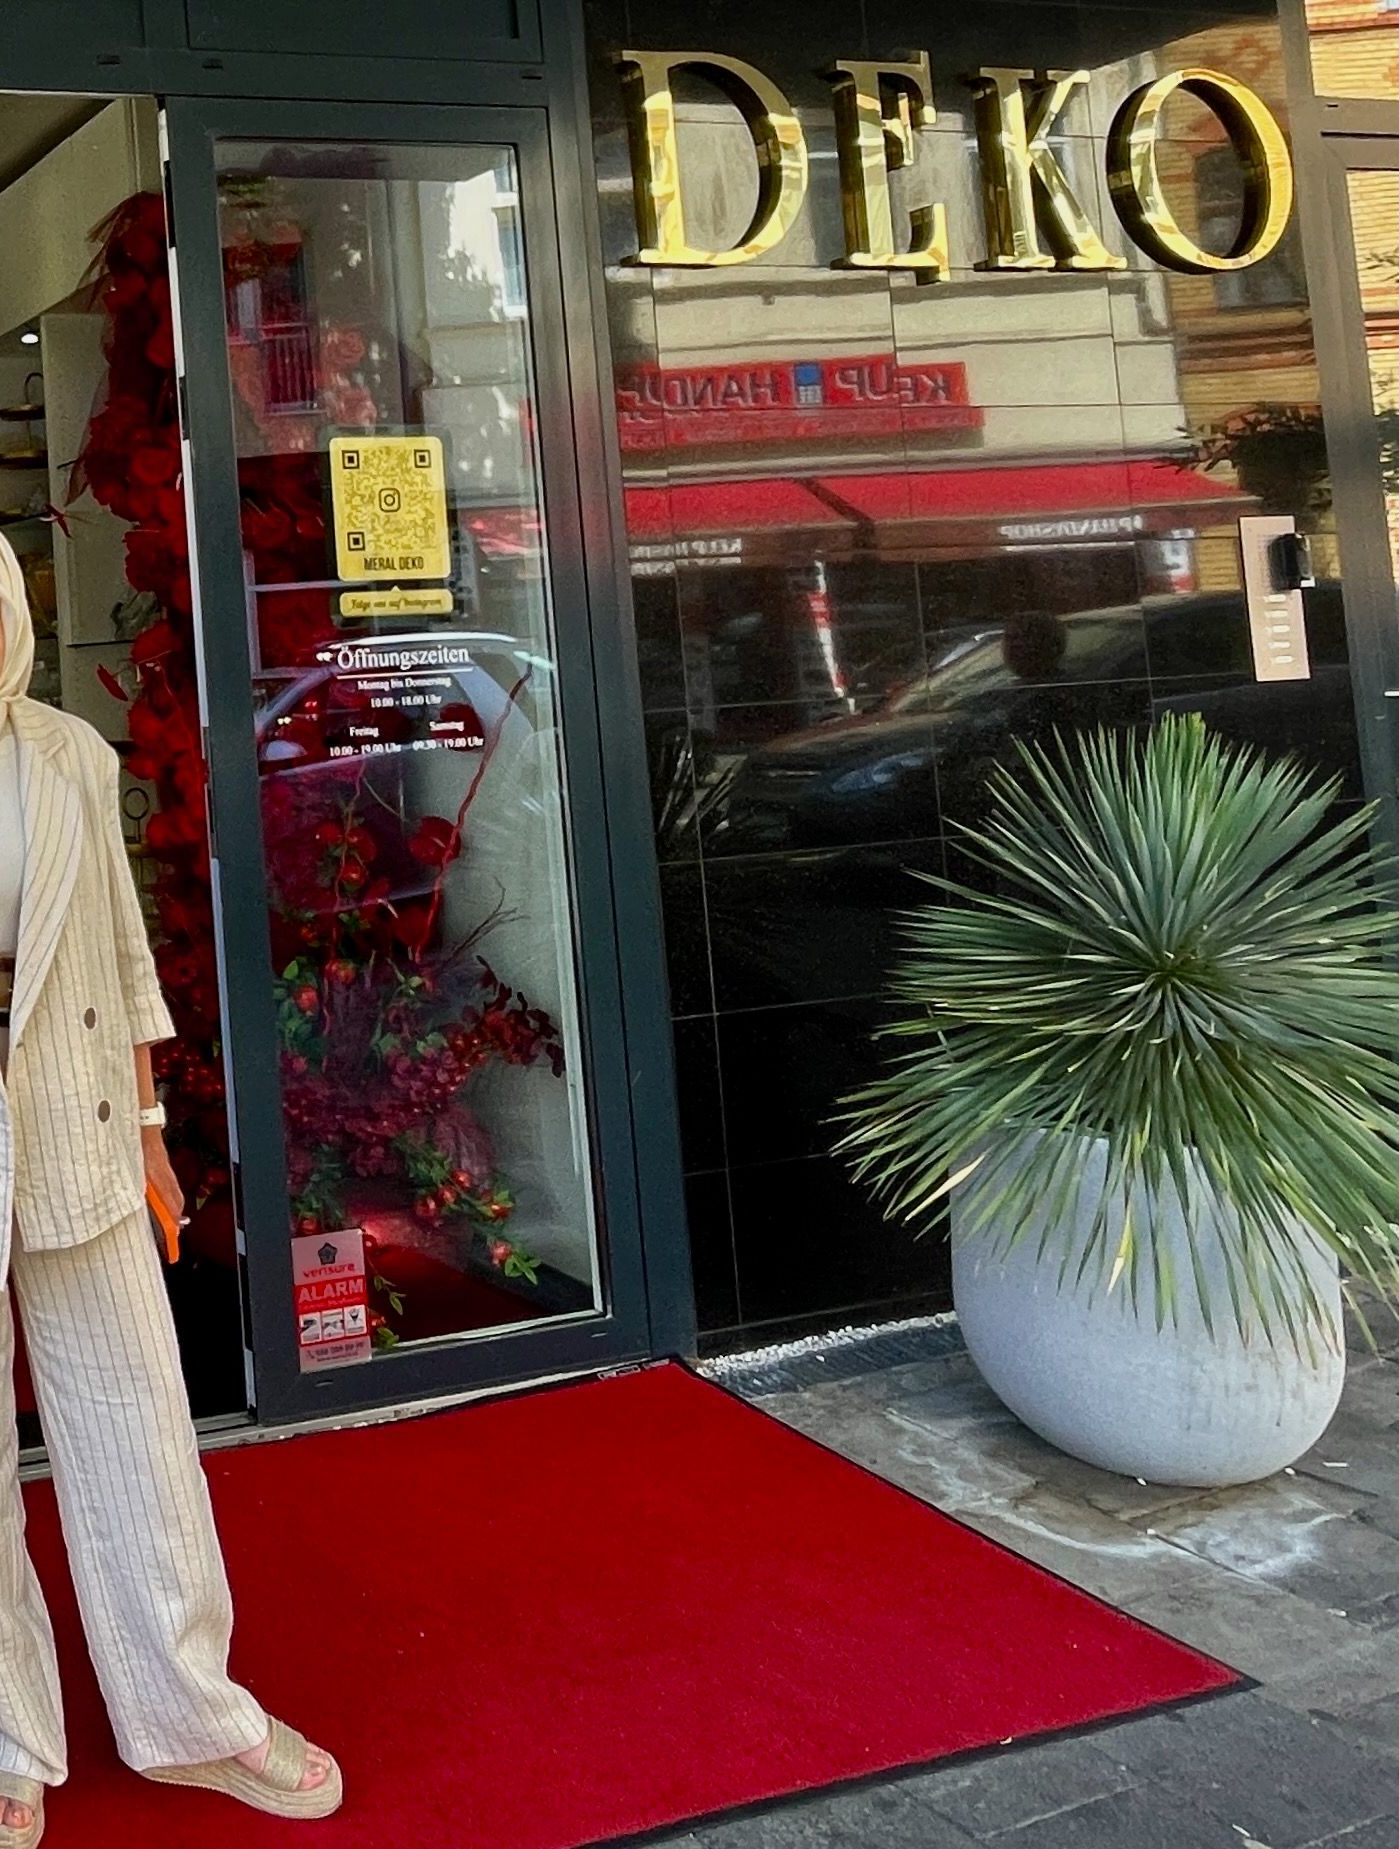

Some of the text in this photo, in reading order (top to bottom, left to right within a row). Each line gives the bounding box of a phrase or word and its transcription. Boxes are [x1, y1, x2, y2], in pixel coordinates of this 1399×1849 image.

[620, 49, 1293, 284] DEKO
[363, 556, 424, 571] MERAL DEKO
[337, 644, 471, 670] Öffnungszeiten
[358, 676, 452, 691] Montag bis Donnerstag
[371, 697, 394, 708] 10.00
[426, 694, 442, 704] Uhr
[349, 726, 379, 737] Freitag
[468, 736, 484, 747] Uhr
[330, 746, 353, 757] 10.00
[361, 744, 383, 755] 19.00
[385, 742, 402, 753] Uhr
[303, 1263, 355, 1278] verisure
[298, 1278, 364, 1304] ALARM
